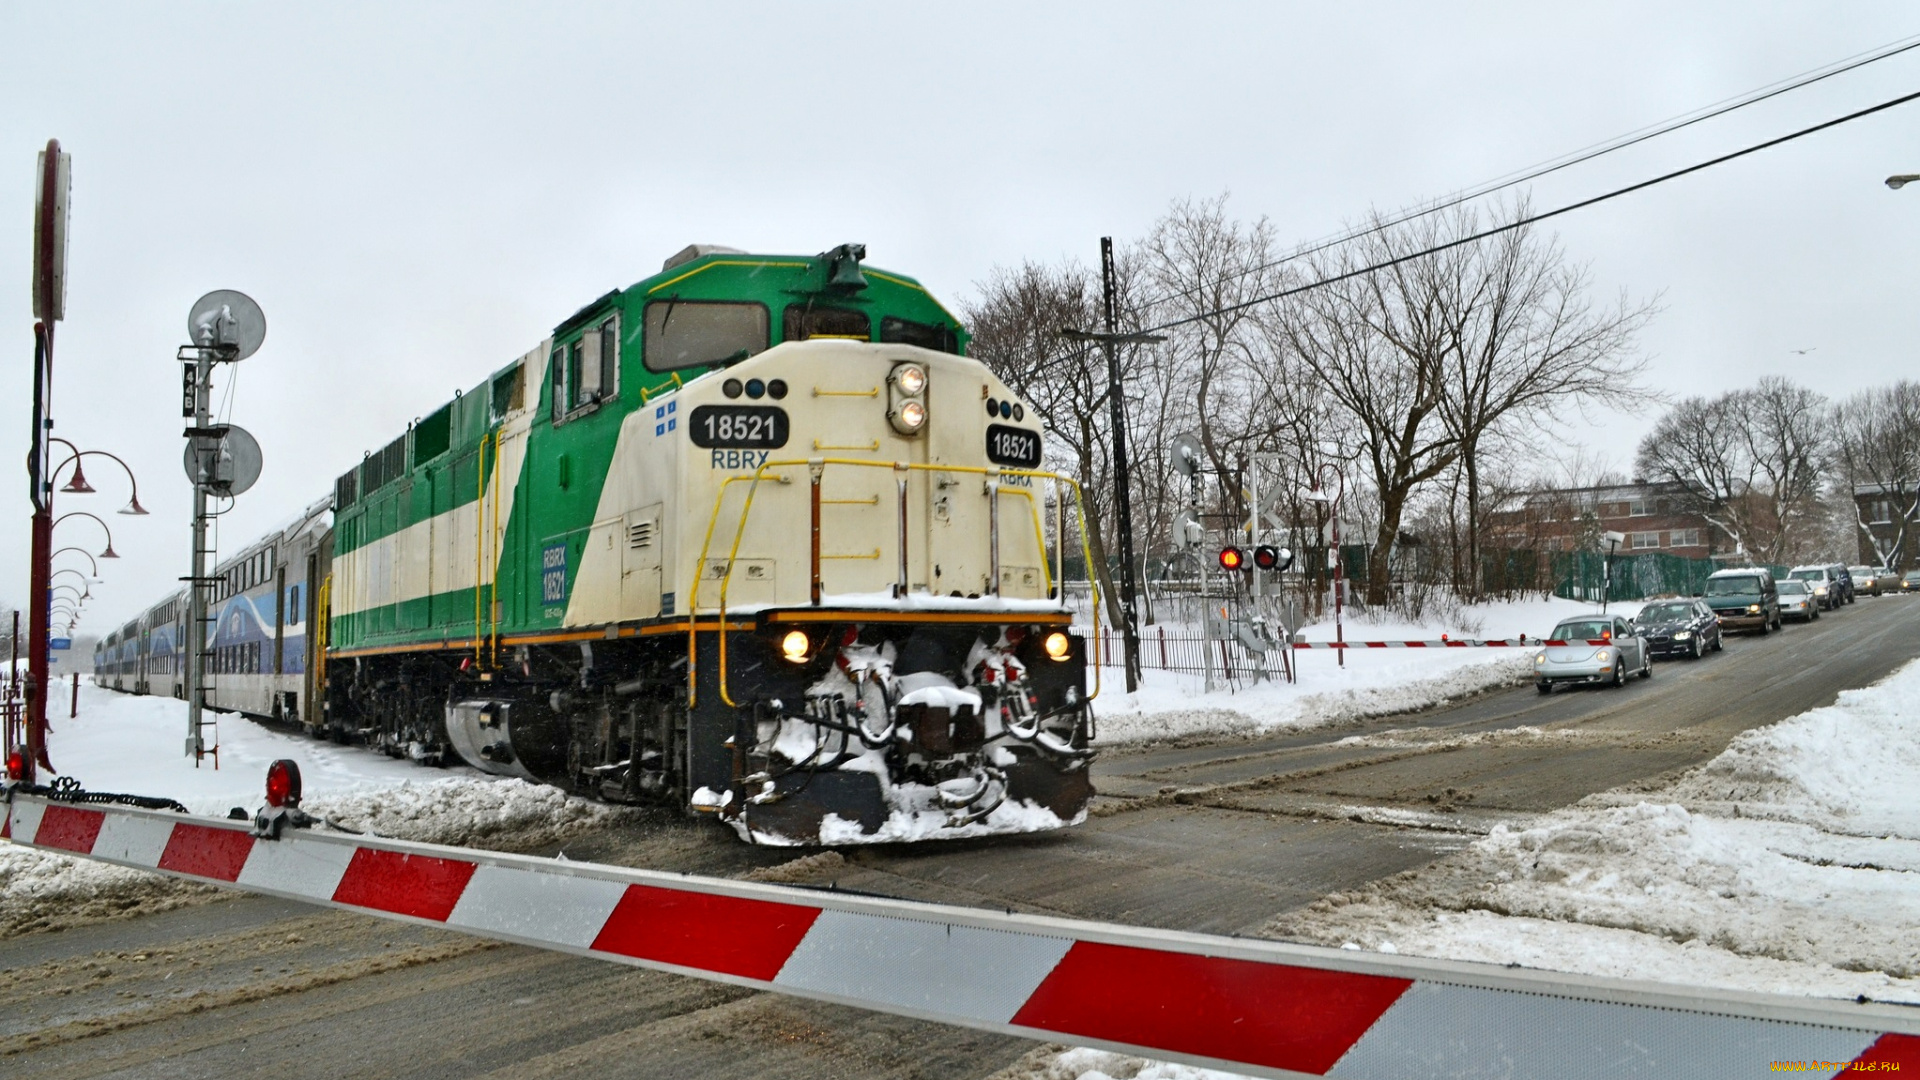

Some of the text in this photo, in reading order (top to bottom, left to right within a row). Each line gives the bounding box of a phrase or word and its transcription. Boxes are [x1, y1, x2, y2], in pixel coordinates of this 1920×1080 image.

[704, 414, 774, 440] 18521
[711, 450, 769, 469] RBRX
[994, 432, 1034, 461] 18521
[544, 546, 565, 569] RBRX
[544, 570, 565, 600] 18521
